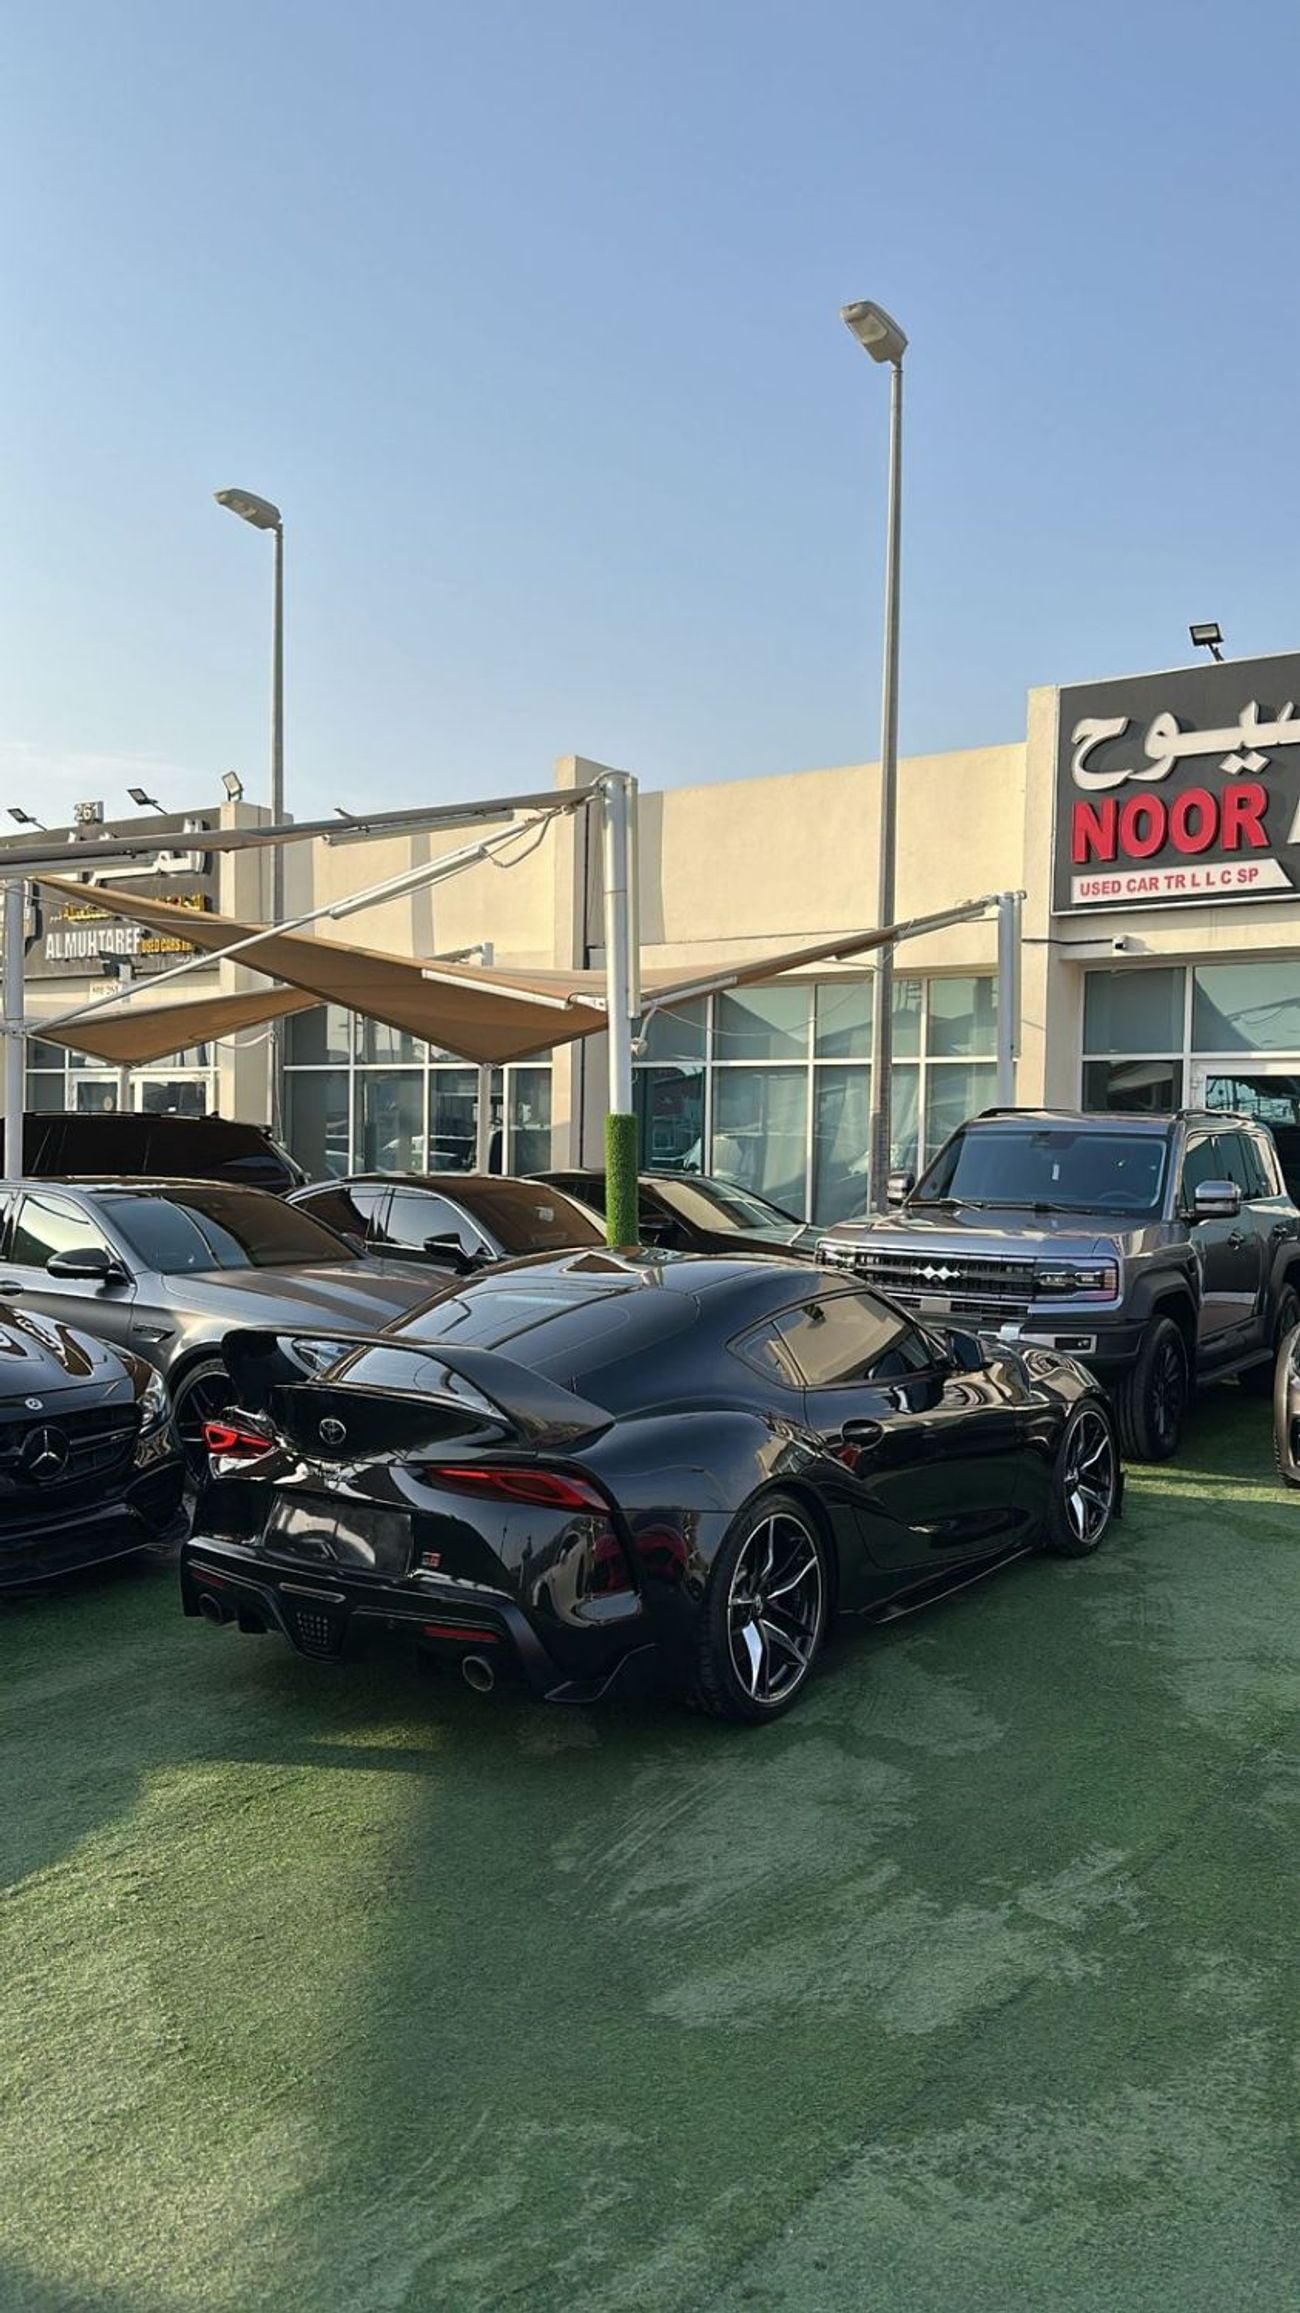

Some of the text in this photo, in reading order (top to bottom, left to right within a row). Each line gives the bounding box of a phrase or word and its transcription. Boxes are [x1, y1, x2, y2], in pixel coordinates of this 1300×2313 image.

[74, 801, 101, 821] 261
[1071, 782, 1270, 863] NOOR
[1080, 880, 1121, 896] USED
[1126, 877, 1159, 892] CAR
[1164, 874, 1186, 889] TR
[1237, 867, 1259, 883] SP
